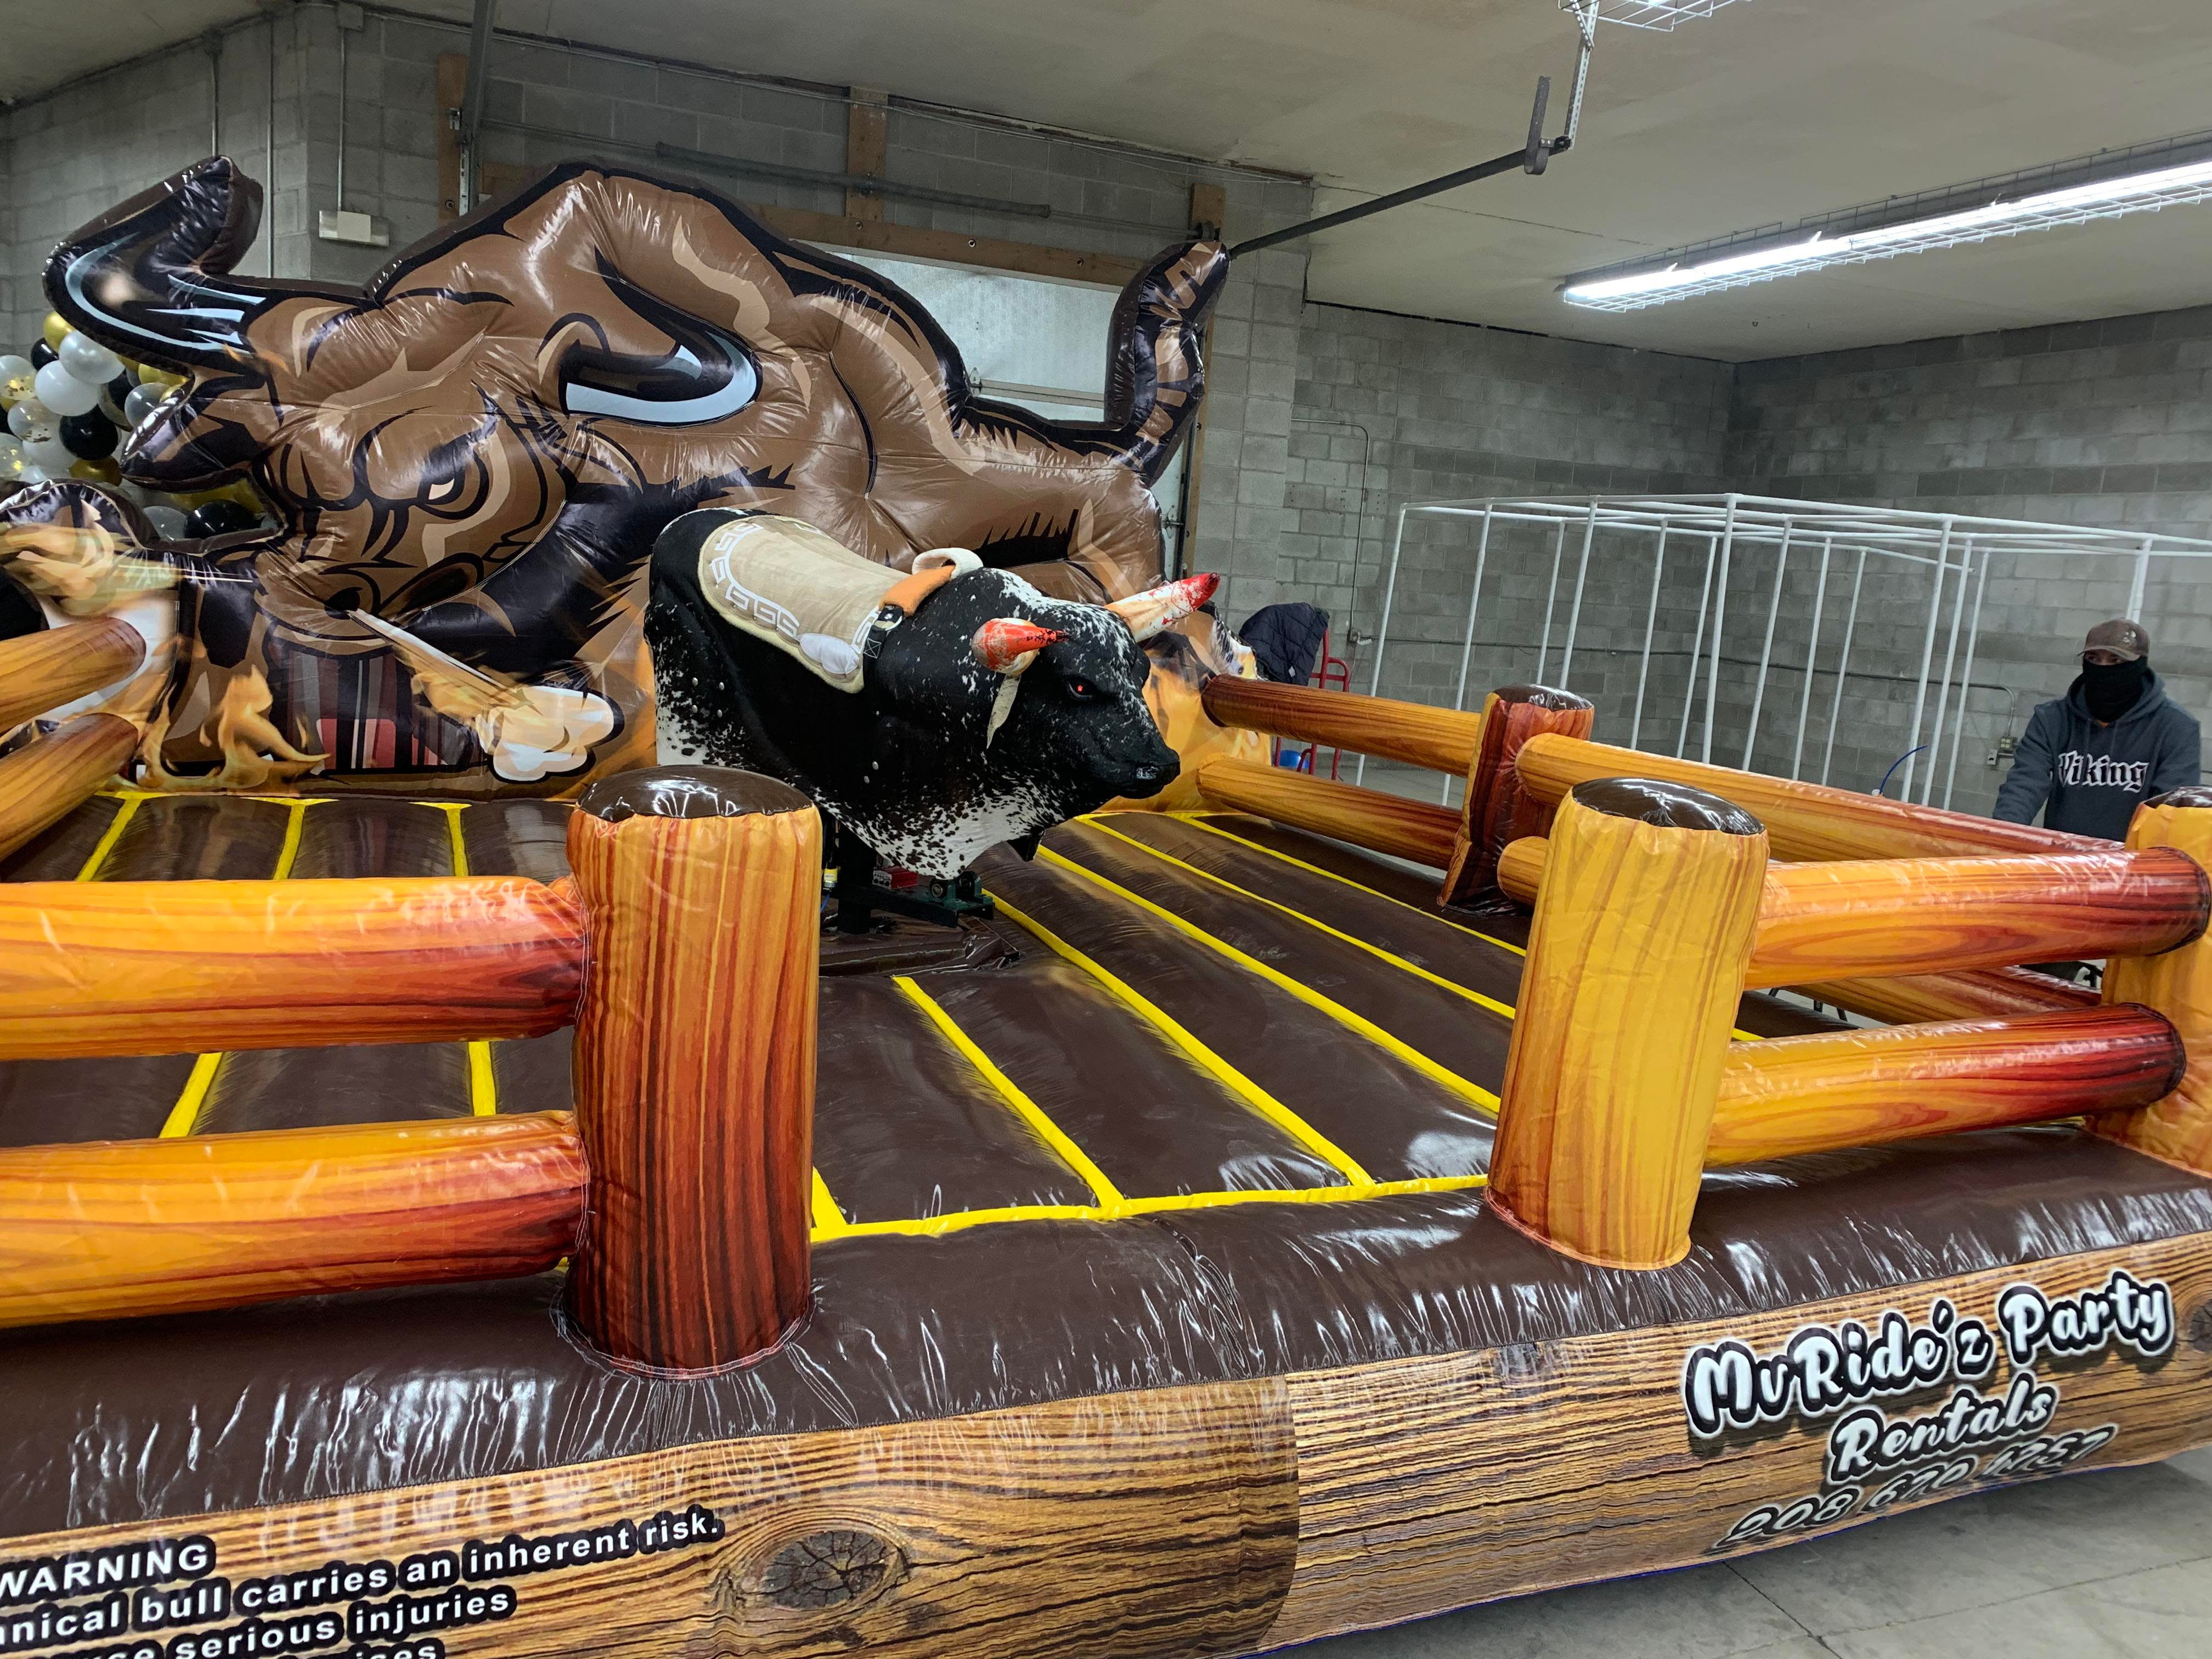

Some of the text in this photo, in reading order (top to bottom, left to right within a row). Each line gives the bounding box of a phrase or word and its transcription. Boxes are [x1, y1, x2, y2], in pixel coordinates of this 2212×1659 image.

[2058, 750, 2149, 793] Viking
[2002, 1277, 2169, 1353] Party
[1835, 1378, 2053, 1474] Rentals
[1723, 1492, 1854, 1543] 208
[0, 1543, 208, 1599] WARNING
[140, 1585, 222, 1624] bull
[241, 1566, 389, 1609] carries
[405, 1556, 452, 1583] an
[469, 1527, 631, 1573] inherent
[645, 1511, 719, 1546] risk.
[174, 1592, 510, 1659] serious injuries
